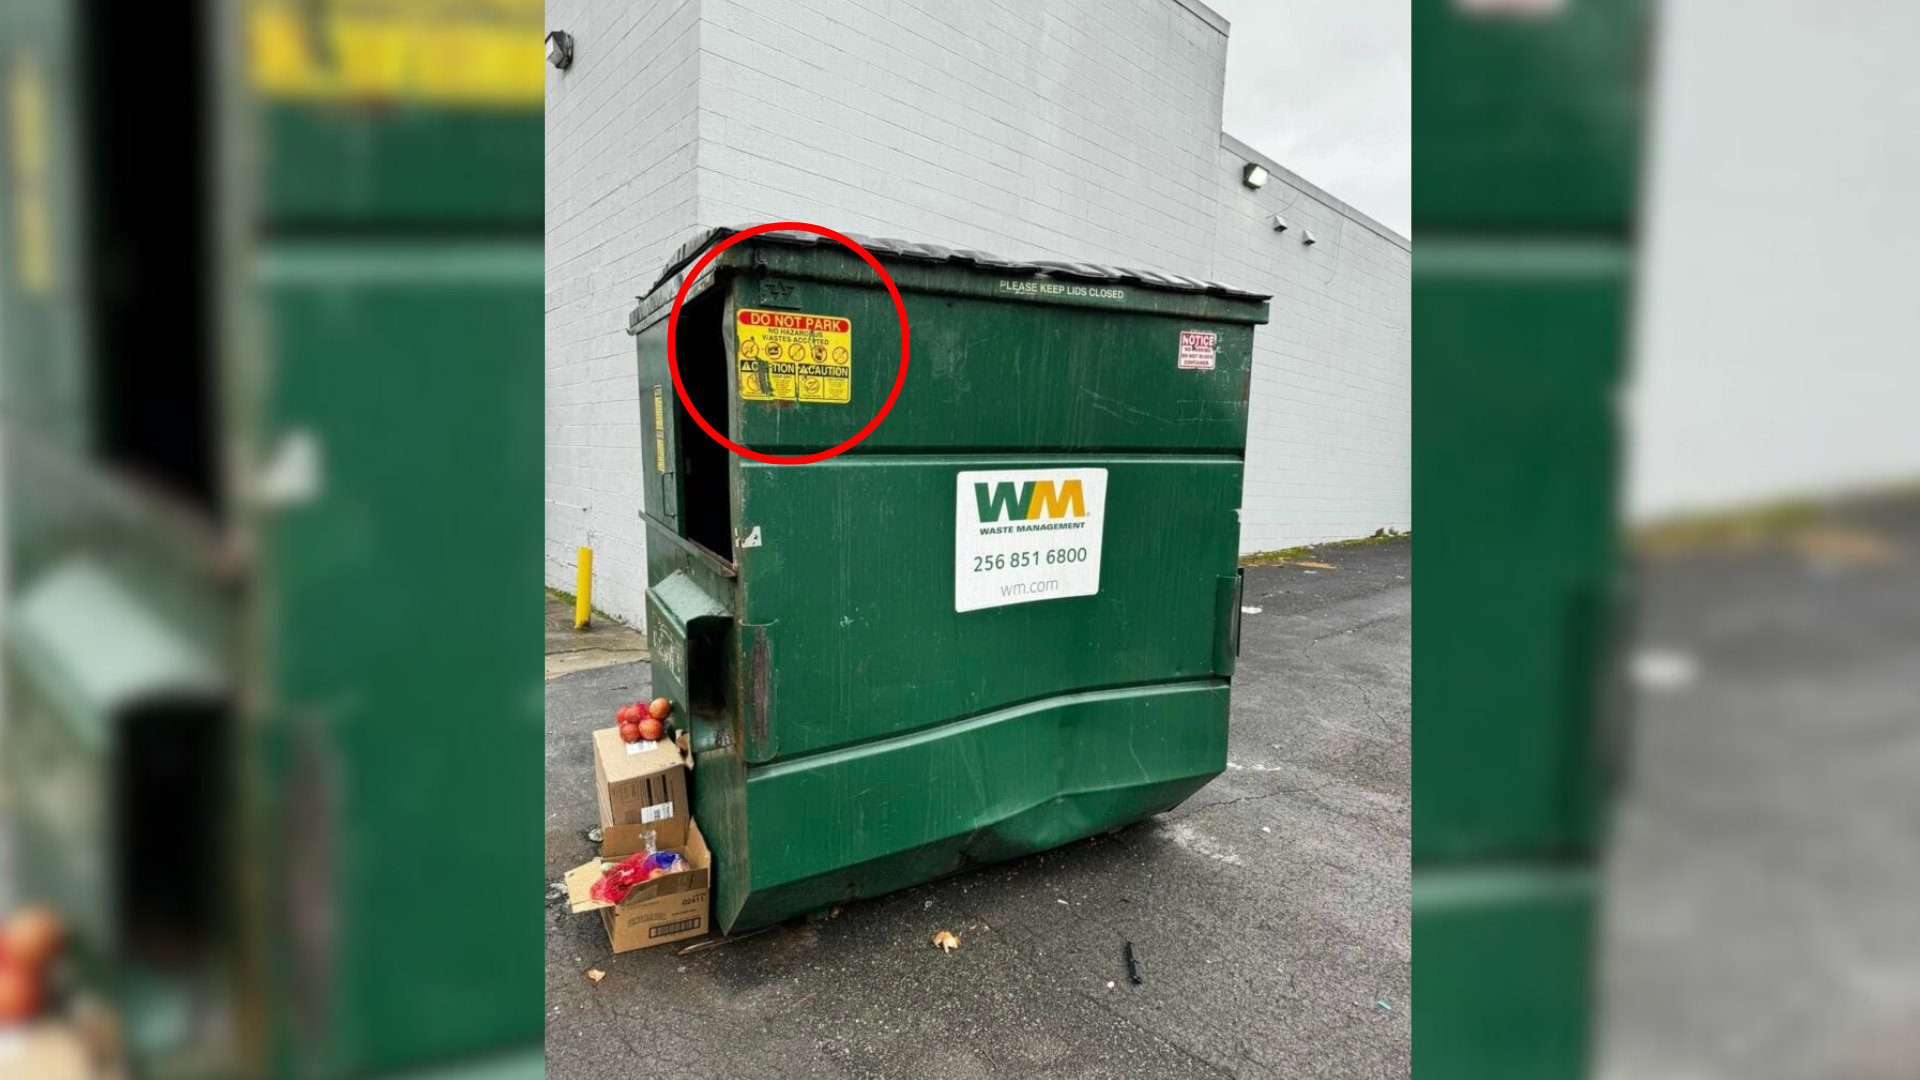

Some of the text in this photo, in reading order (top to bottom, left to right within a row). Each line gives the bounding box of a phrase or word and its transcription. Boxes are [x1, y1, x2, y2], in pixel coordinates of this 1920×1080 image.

[1000, 280, 1124, 299] PLEASE KEEP LIDS CLOSED
[750, 312, 841, 331] DO NOT PARK
[768, 327, 779, 335] NO
[762, 334, 792, 343] WASTES
[1182, 334, 1215, 346] NOTICE
[751, 361, 795, 374] CTION
[808, 365, 848, 377] CAUTION
[974, 479, 1086, 523] WM
[979, 521, 1086, 535] WASTE MANAGEMENT
[973, 547, 1087, 572] 256 851 6800
[1000, 579, 1058, 597] wm.com
